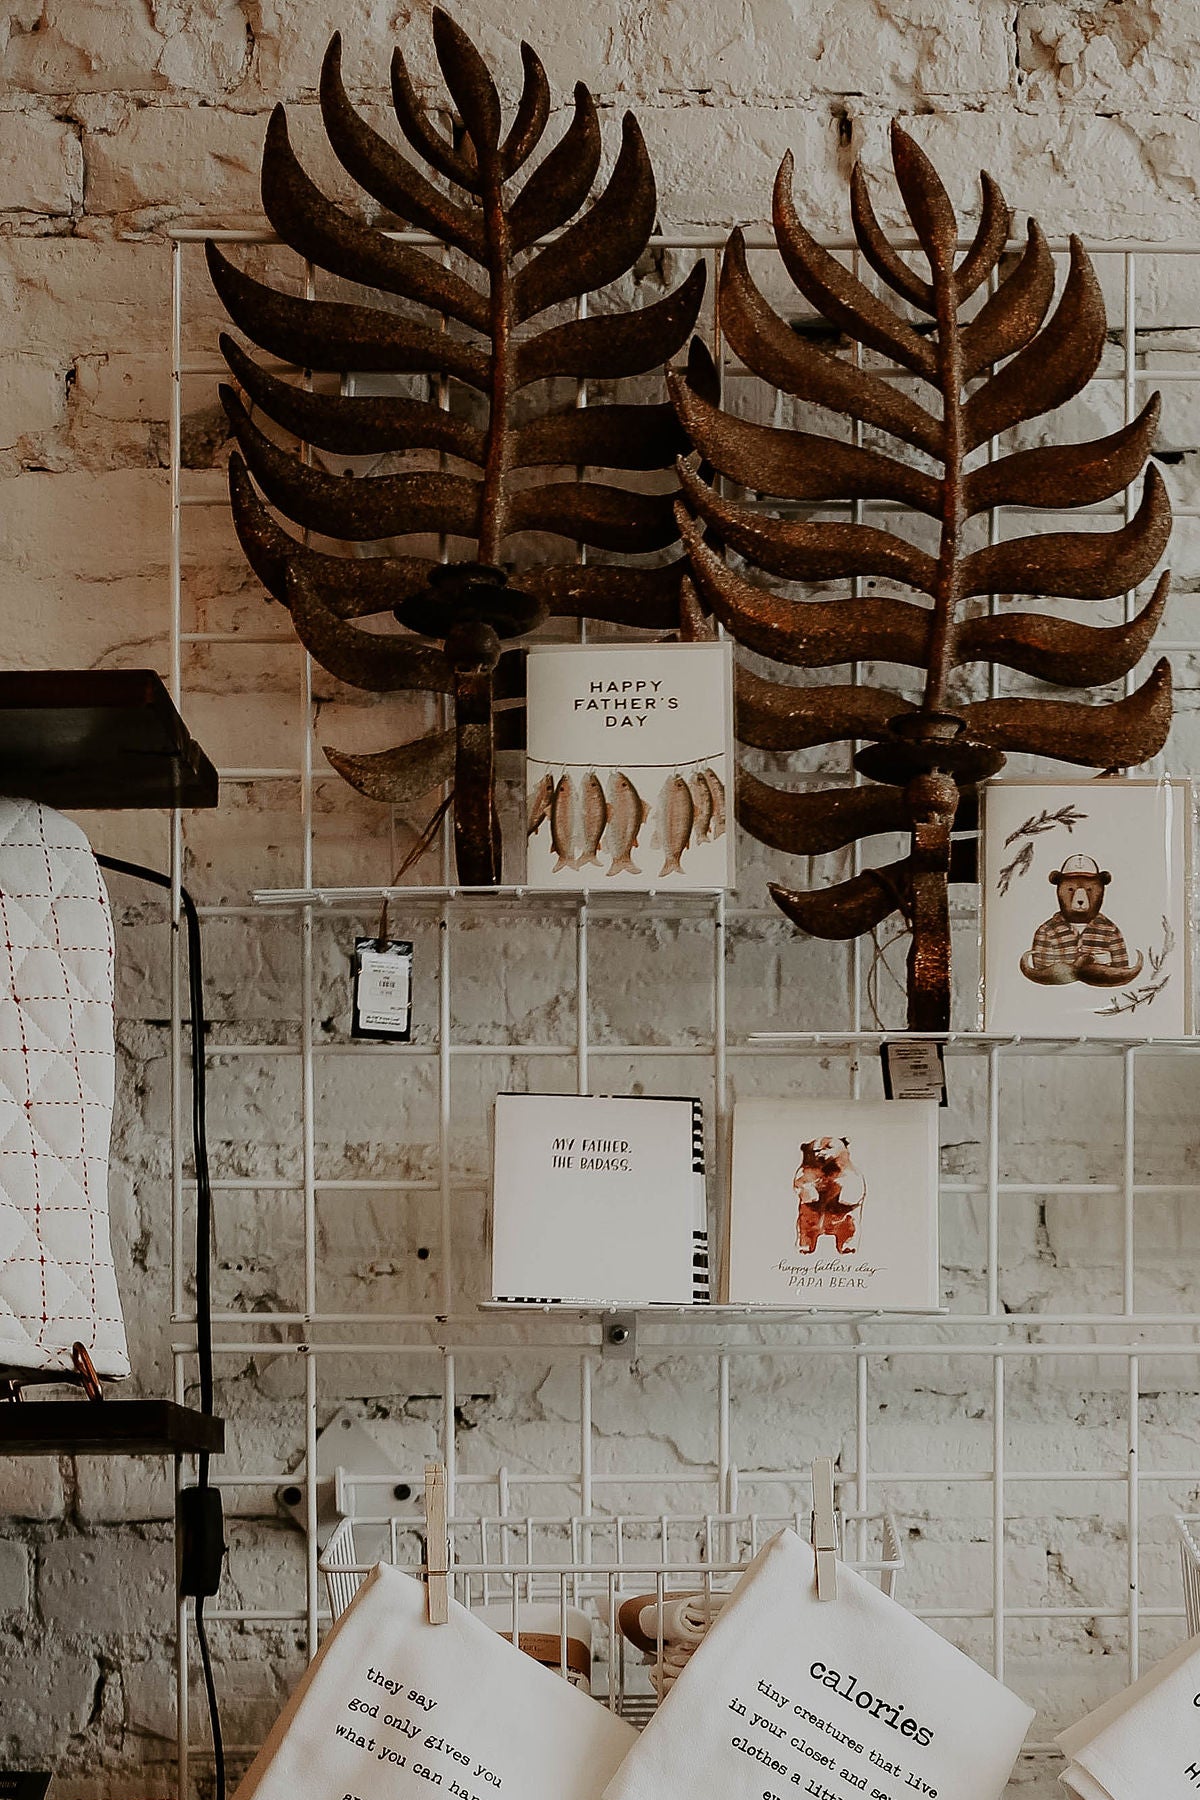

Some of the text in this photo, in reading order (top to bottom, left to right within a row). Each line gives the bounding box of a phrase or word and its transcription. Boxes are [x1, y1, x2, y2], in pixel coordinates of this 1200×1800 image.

[590, 680, 662, 693] HAPPY
[574, 697, 679, 711] FATHER'S
[605, 715, 648, 727] DAY
[552, 1138, 633, 1154] MY FATHER.
[552, 1155, 633, 1171] THE BADASS.
[772, 1259, 811, 1275] happy
[854, 1263, 888, 1277] day
[788, 1276, 869, 1289] PAPA BEAR
[366, 1666, 439, 1712] they say
[809, 1661, 935, 1747] calories
[335, 1724, 377, 1753] what
[376, 1746, 407, 1768] you
[412, 1763, 443, 1786] can
[347, 1697, 502, 1789] god only gives you
[727, 1697, 747, 1717] in
[748, 1712, 788, 1739] your
[790, 1737, 837, 1771] closet
[839, 1768, 869, 1792] and
[756, 1678, 938, 1800] tiny creatures that live
[731, 1736, 789, 1776] clothes
[790, 1772, 802, 1786] a
